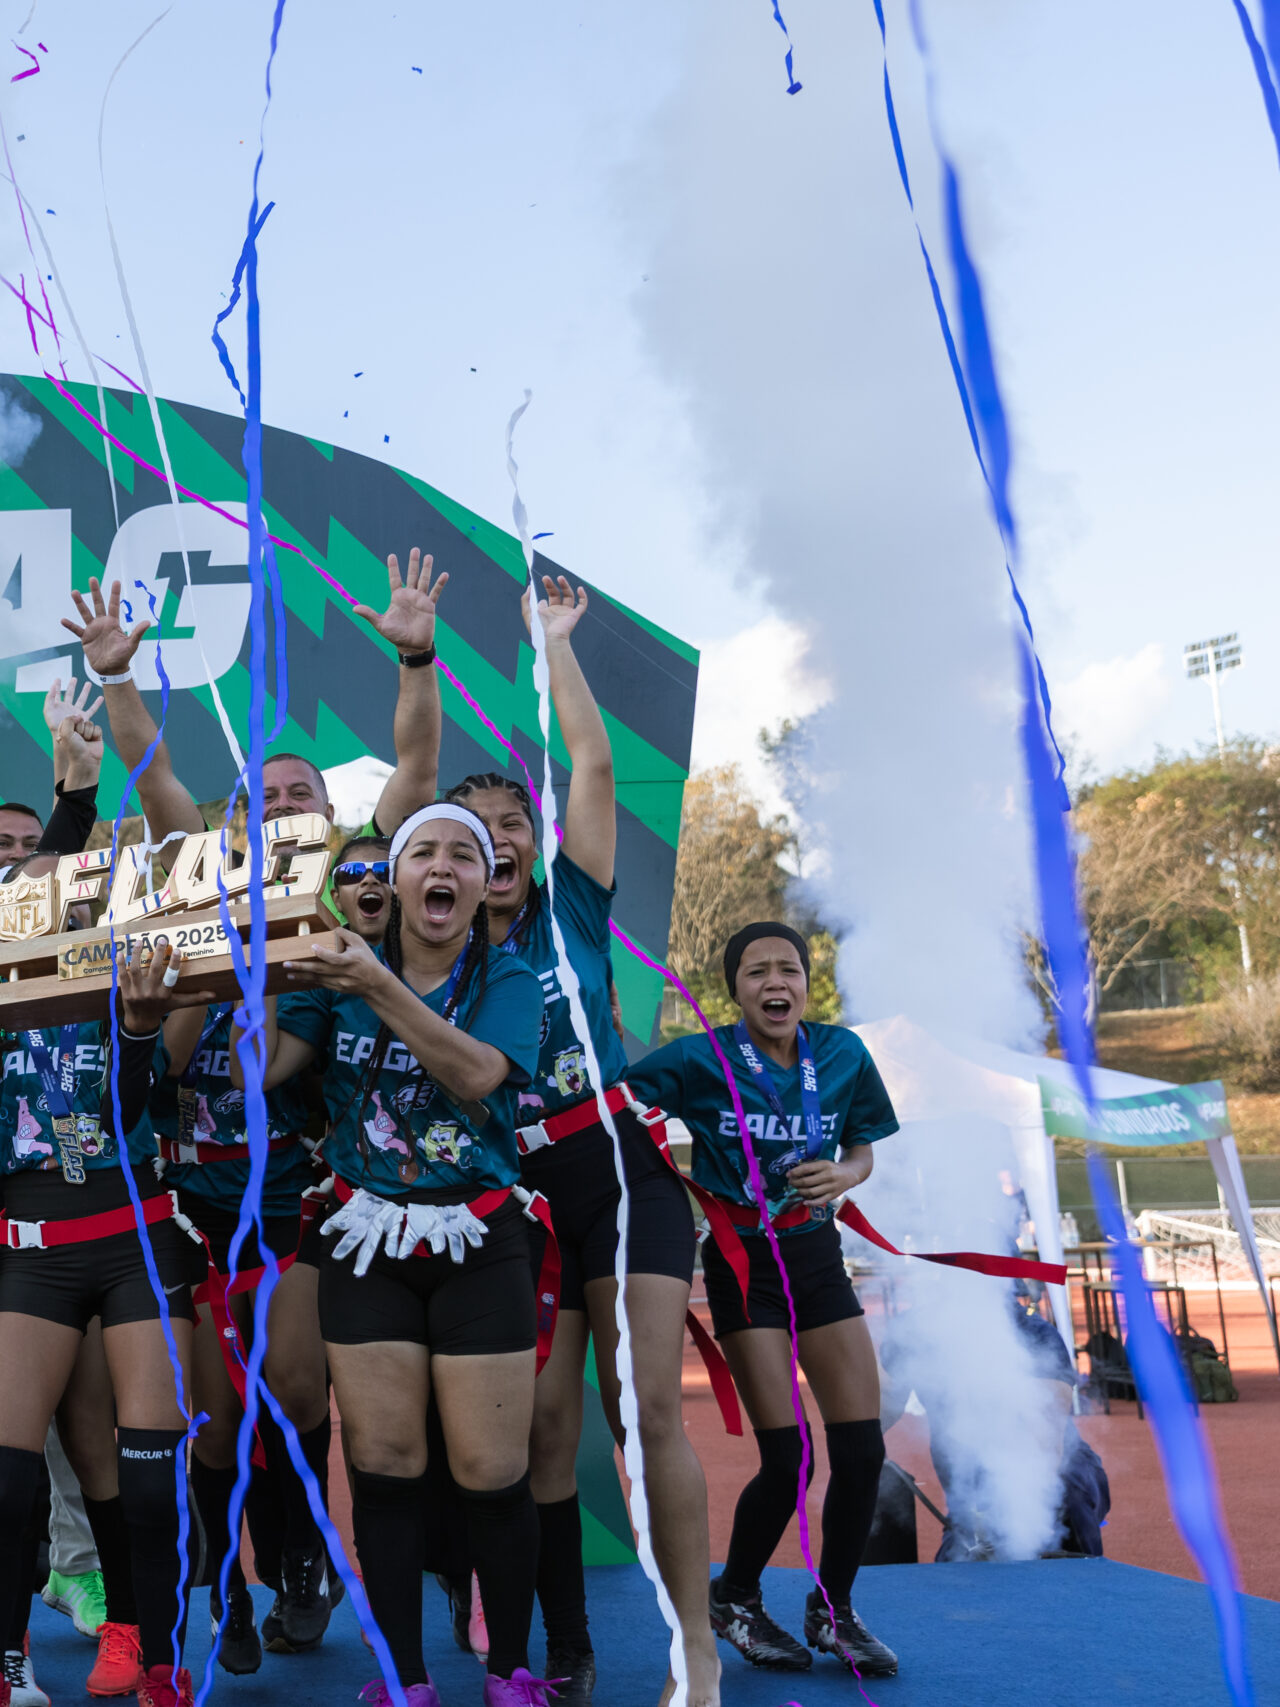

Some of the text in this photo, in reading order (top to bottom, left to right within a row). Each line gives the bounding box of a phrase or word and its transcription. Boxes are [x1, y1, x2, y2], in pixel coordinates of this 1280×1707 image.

[1, 812, 332, 934] NFL FLAG
[64, 924, 229, 966] CAMPEÃO 2025
[183, 948, 215, 959] Feminino
[27, 1029, 45, 1047] LAG
